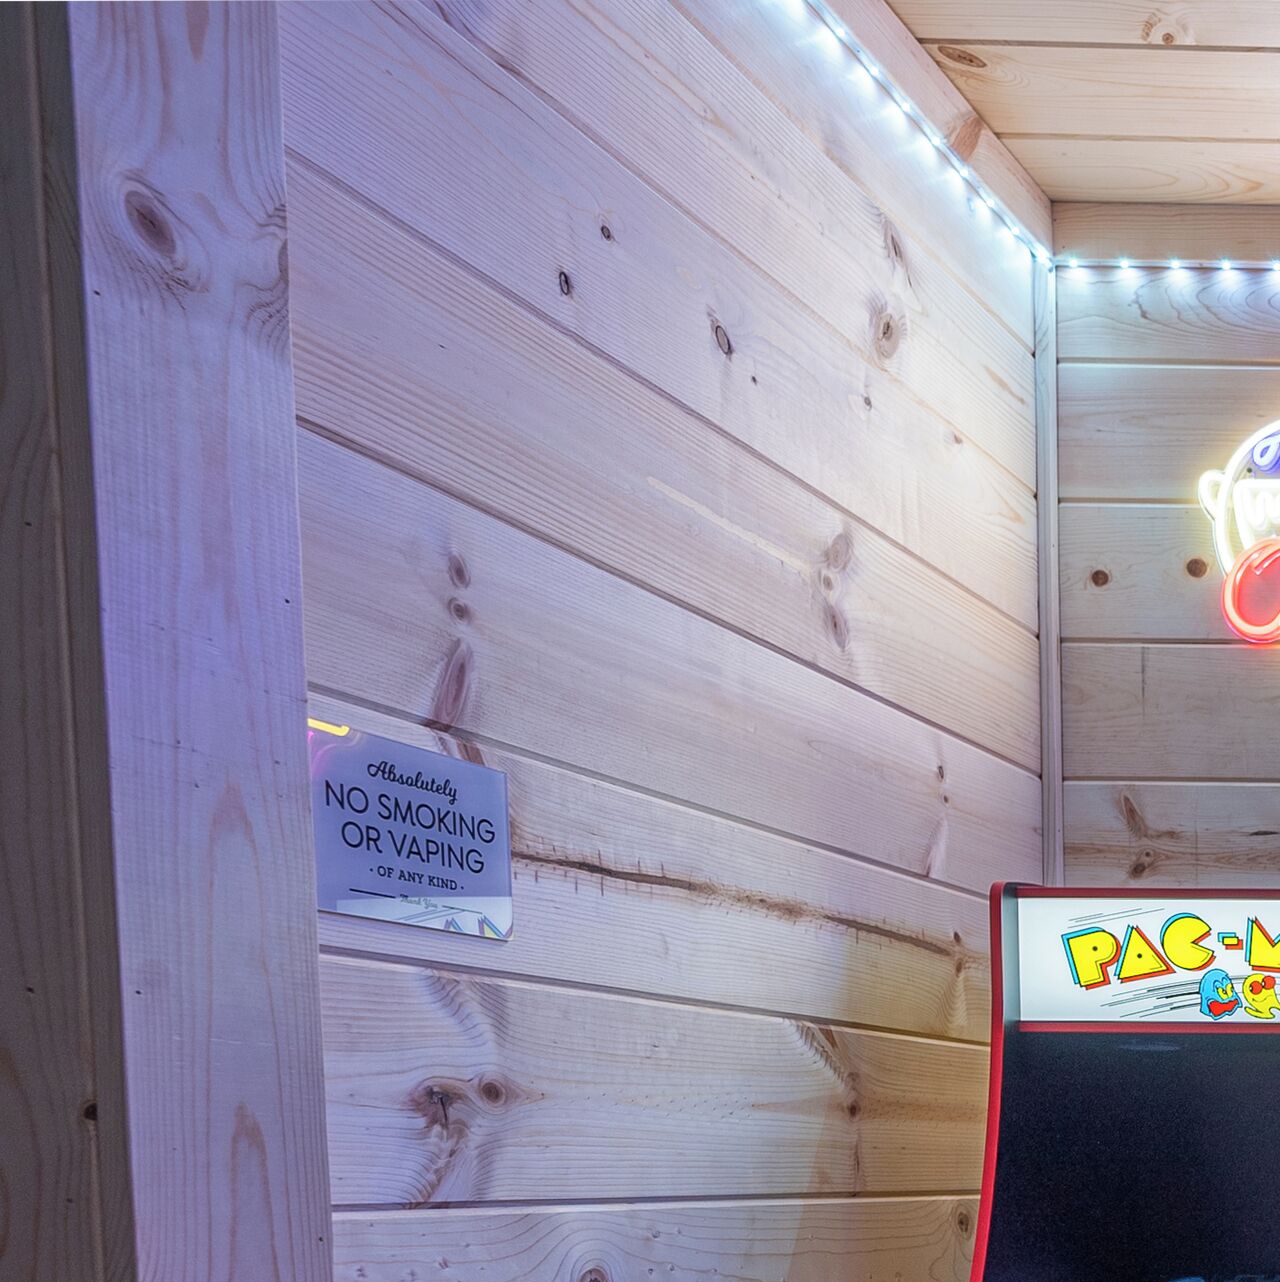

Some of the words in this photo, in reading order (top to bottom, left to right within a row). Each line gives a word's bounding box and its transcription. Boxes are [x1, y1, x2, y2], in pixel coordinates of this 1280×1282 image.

[366, 760, 458, 806] Absolutely
[325, 780, 368, 814] NO
[377, 793, 496, 844] SMOKING
[341, 821, 382, 853] OR
[387, 829, 485, 874] VAPING
[377, 865, 394, 879] OF
[398, 869, 424, 885] ANY
[428, 874, 458, 891] KIND
